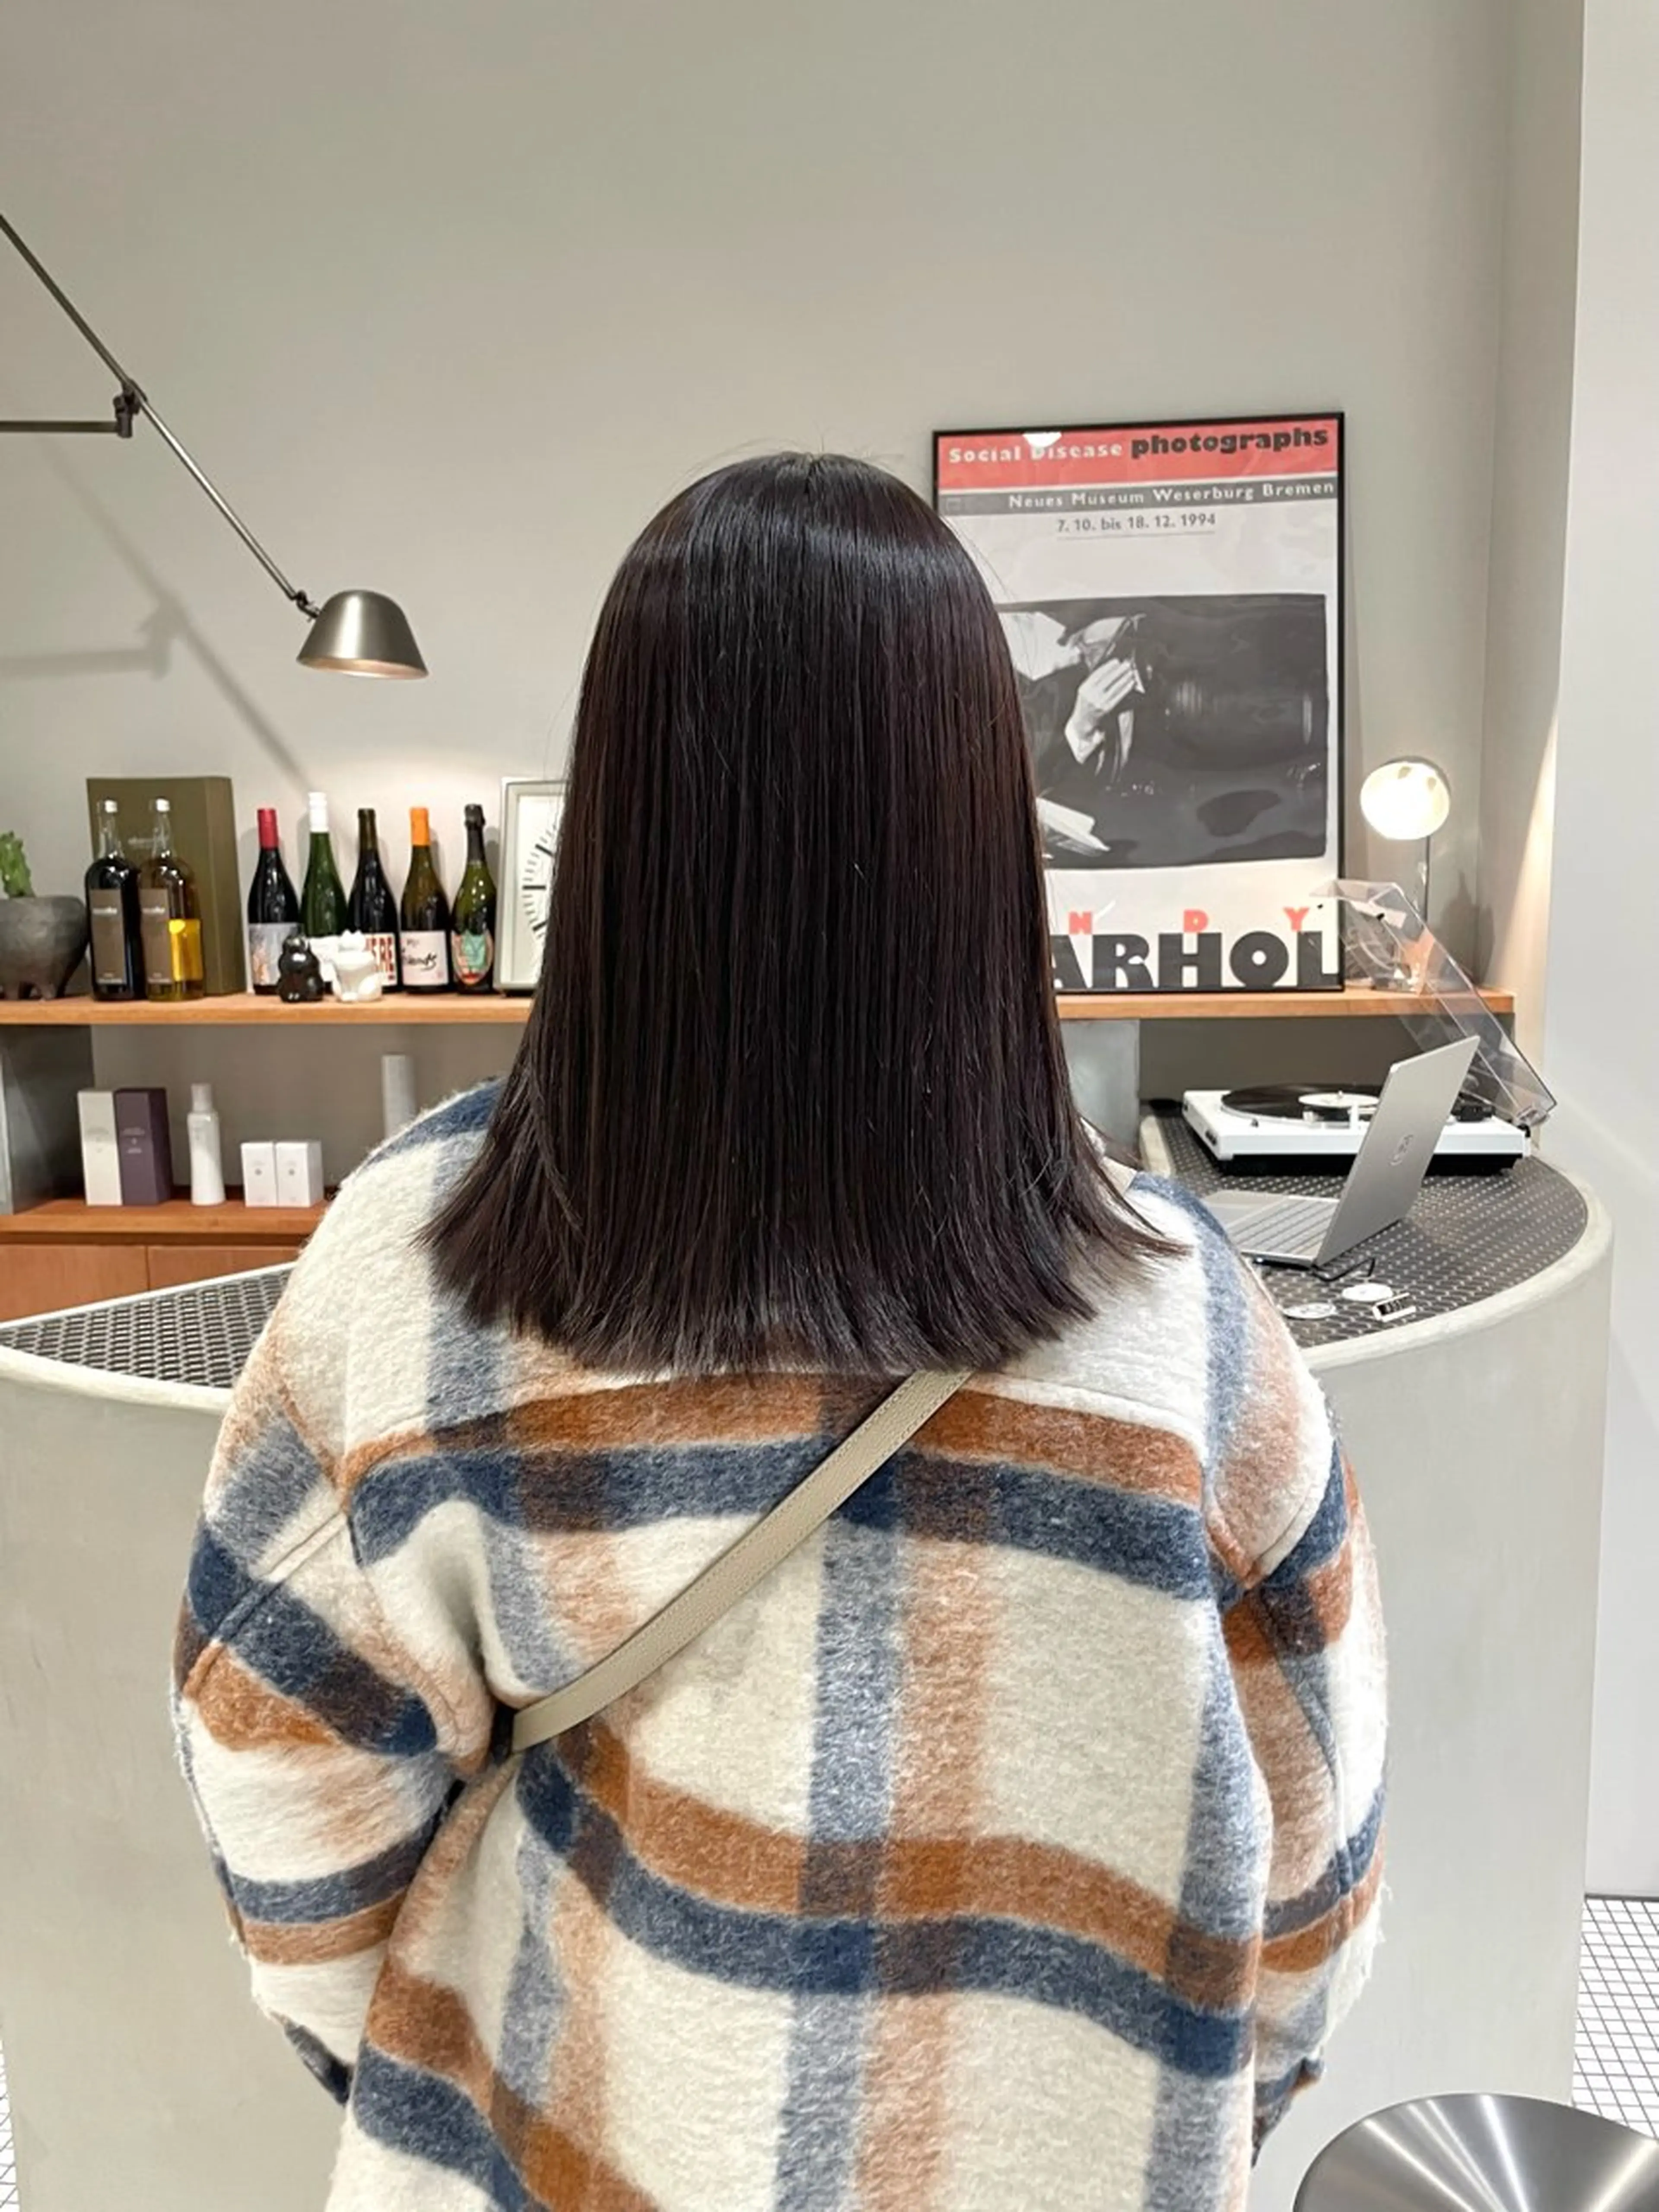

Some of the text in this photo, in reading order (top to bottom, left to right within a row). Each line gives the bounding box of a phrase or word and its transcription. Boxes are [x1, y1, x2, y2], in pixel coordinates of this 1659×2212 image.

[949, 427, 1328, 464] Social Disease photographs
[1009, 483, 1334, 509] Neues Museum Weserburg Bremen
[1058, 513, 1216, 531] 7. 10. bis 18. 12. 1994
[1049, 931, 1339, 988] ARHOL
